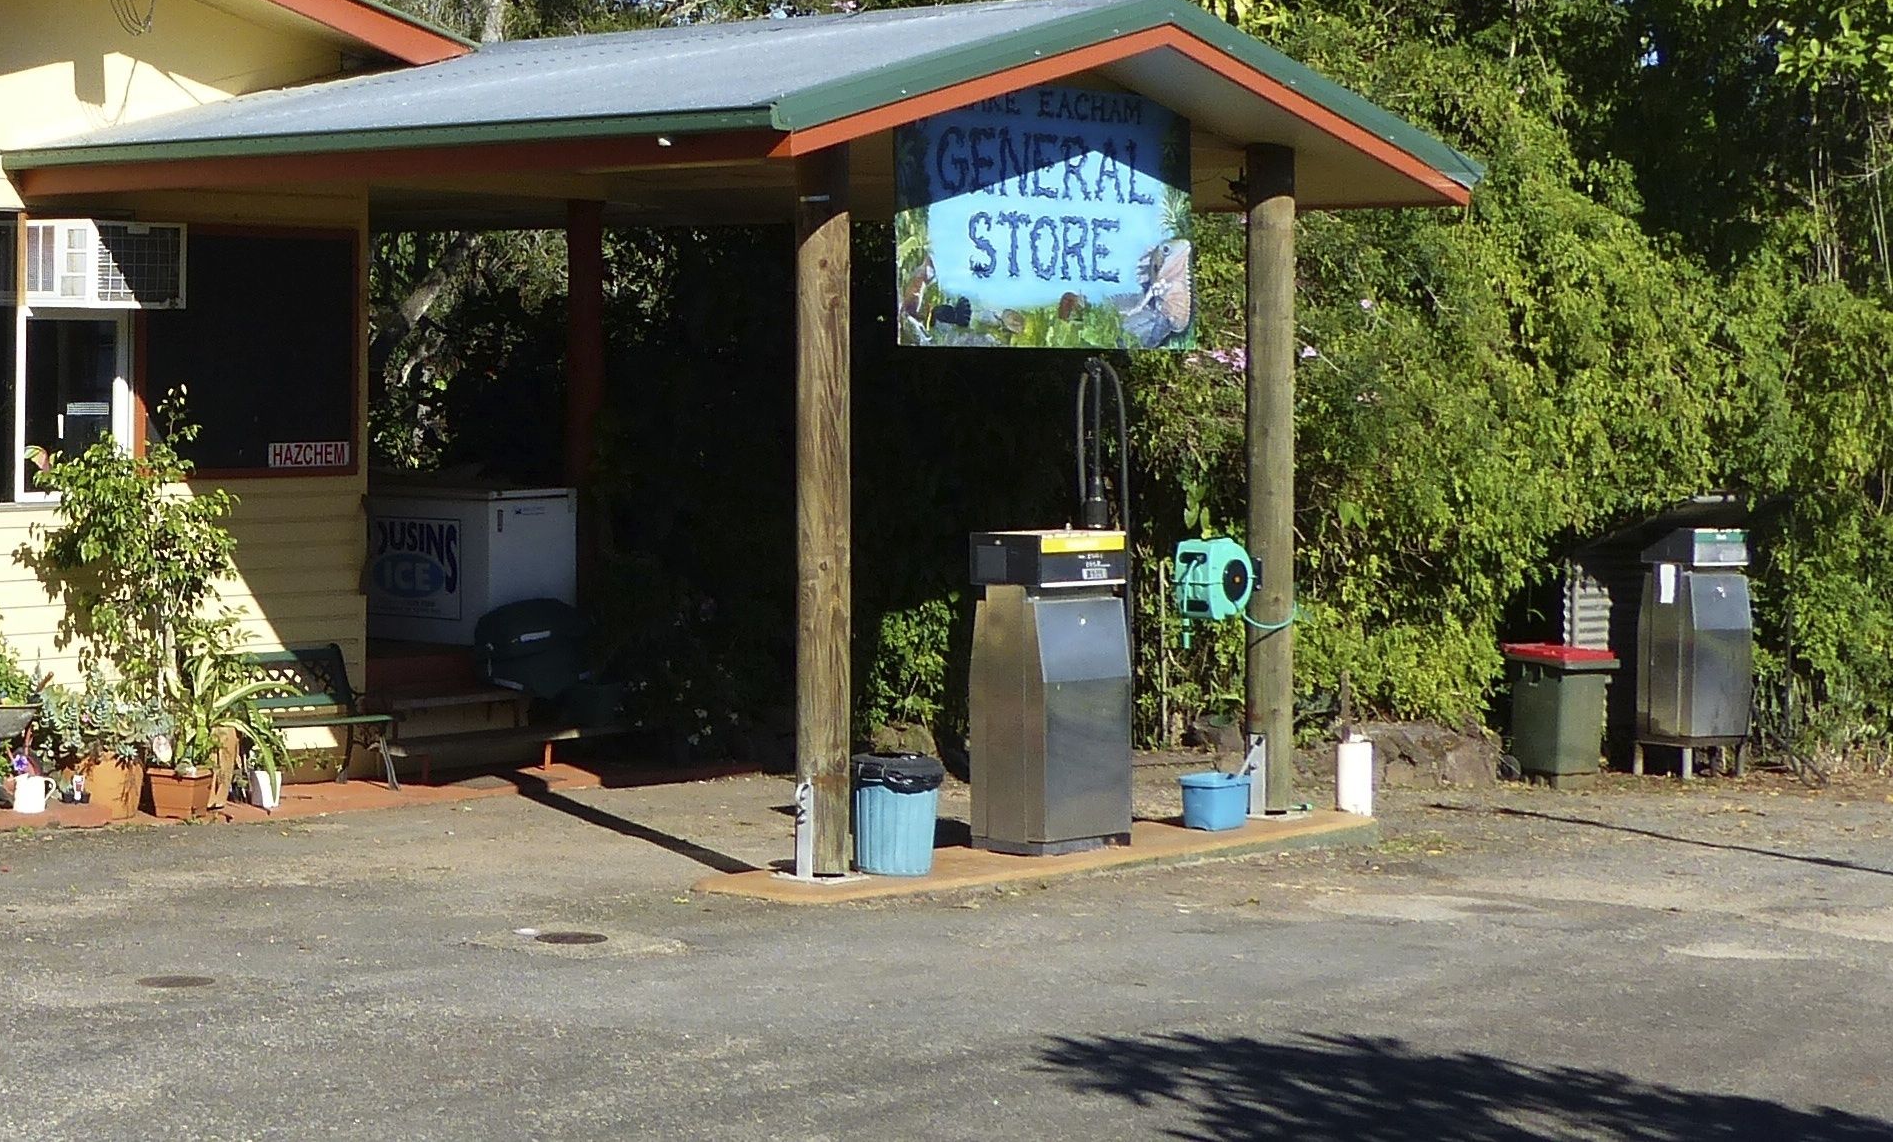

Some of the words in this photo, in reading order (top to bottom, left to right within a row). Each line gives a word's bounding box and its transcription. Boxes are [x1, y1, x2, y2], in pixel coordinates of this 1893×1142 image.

[1038, 89, 1142, 124] EACHAM
[936, 126, 1155, 205] GENERAL
[969, 211, 1119, 283] STORE
[272, 445, 346, 467] HAZCHEM
[382, 561, 431, 591] ICE
